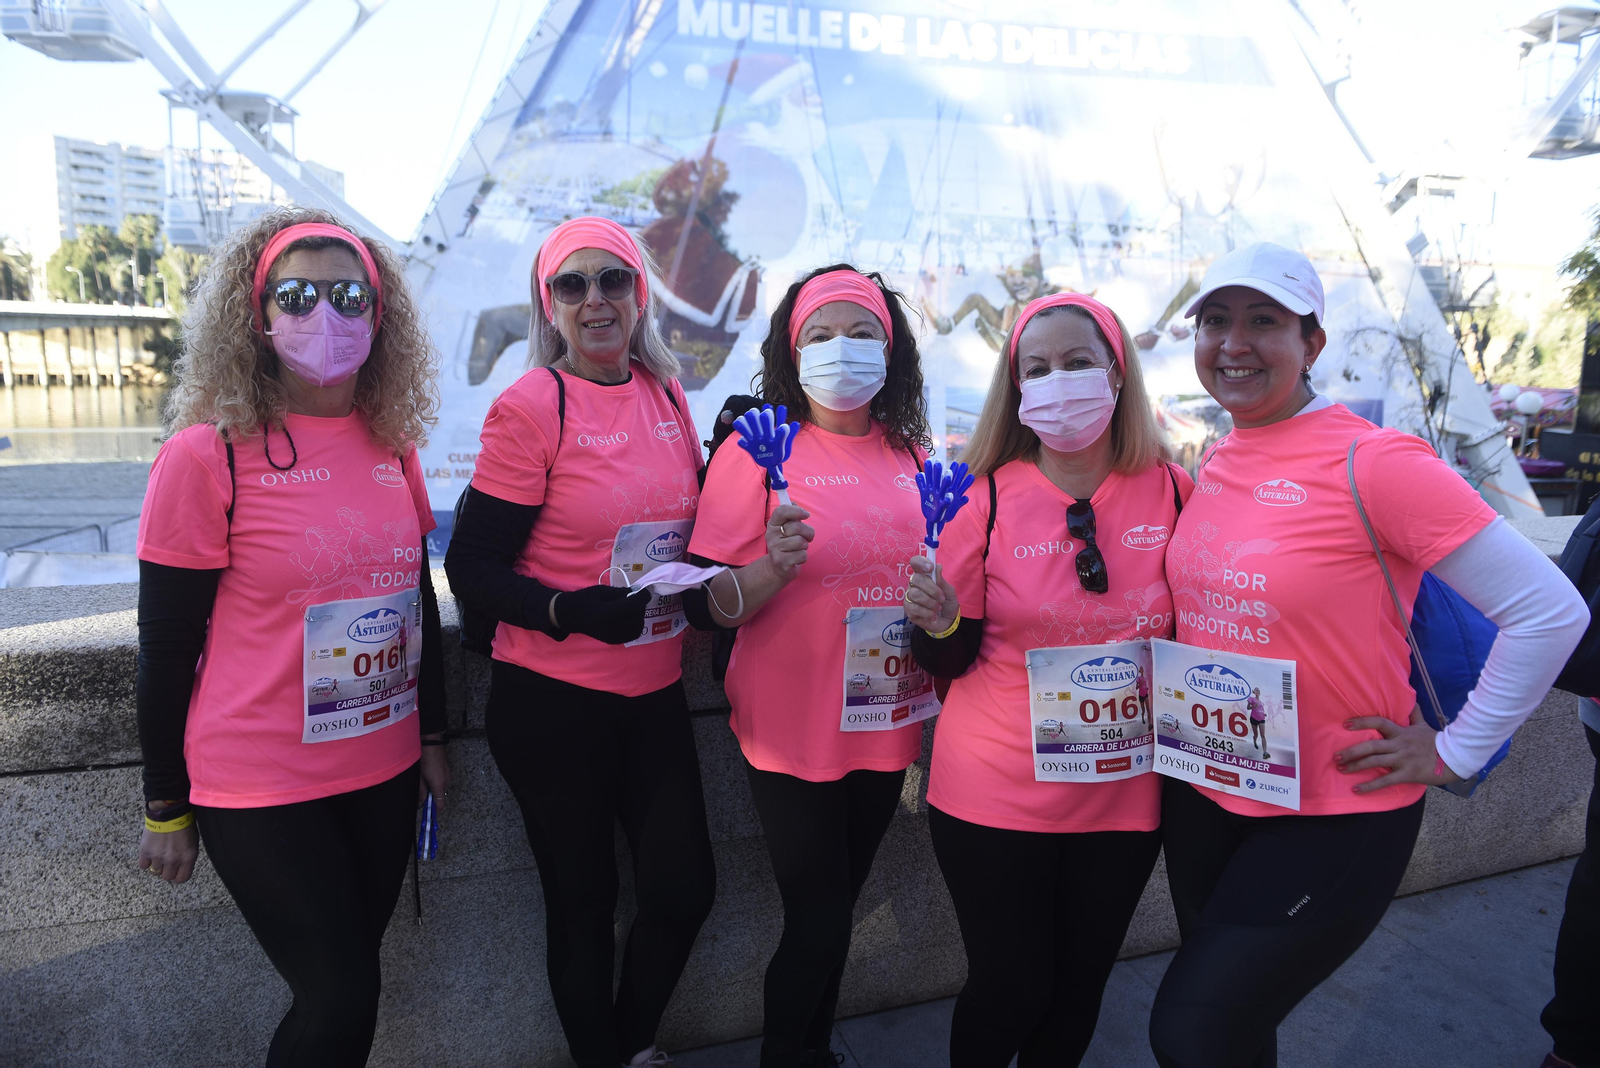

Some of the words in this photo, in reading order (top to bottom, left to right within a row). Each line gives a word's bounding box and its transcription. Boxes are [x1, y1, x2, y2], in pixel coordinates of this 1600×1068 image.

[677, 0, 844, 49] MUELLE
[849, 12, 905, 55] DE
[916, 17, 998, 62] LAS
[1002, 24, 1191, 75] DELICIAS
[577, 431, 629, 447] OYSHO
[448, 453, 477, 463] CUM
[261, 467, 331, 486] OYSHO
[426, 468, 451, 479] LAS
[455, 468, 473, 479] ME
[805, 474, 859, 487] OYSHO
[1194, 481, 1223, 496] YSHO
[1257, 487, 1301, 503] ASTURIANA
[682, 496, 698, 511] PO
[393, 547, 421, 563] POR
[650, 543, 683, 556] ASTURIANA
[1014, 540, 1074, 559] OYSHO
[370, 570, 420, 588] TODAS
[1223, 569, 1267, 592] POR
[658, 595, 672, 606] 503
[1203, 590, 1268, 618] TODAS
[645, 608, 660, 617] RERA
[352, 620, 400, 638] ASTURIANA
[1136, 612, 1172, 631] POR
[1179, 609, 1271, 644] NOSOTRAS
[353, 645, 399, 677] 016
[884, 654, 918, 677] 016
[1076, 669, 1136, 683] ASTURIANA
[369, 678, 387, 692] 501
[897, 679, 909, 692] 505
[1189, 673, 1247, 697] ASTURIANA
[336, 695, 372, 710] CARRERA
[373, 693, 382, 702] DE
[383, 690, 390, 699] LA
[391, 683, 409, 696] MUJER
[899, 693, 905, 701] DE
[905, 691, 911, 700] LA
[847, 711, 887, 724] OYSHO
[1079, 695, 1139, 724] 016
[311, 716, 359, 733] OYSHO
[1191, 703, 1249, 737] 016
[1100, 727, 1124, 741] 504
[1064, 742, 1105, 753] CARRERA
[1107, 741, 1118, 751] DE
[1119, 739, 1130, 750] LA
[1131, 734, 1153, 748] MUJER
[1204, 735, 1234, 753] 2643
[1179, 741, 1213, 759] CARRERA
[1213, 752, 1225, 763] DE
[1225, 755, 1238, 765] LA
[1239, 758, 1270, 772] MUJER
[1041, 761, 1090, 773] OYSHO
[1107, 761, 1128, 770] Santander
[1159, 754, 1200, 774] OYSHO
[1215, 772, 1236, 782] Santander
[1259, 783, 1289, 795] ZURICH
